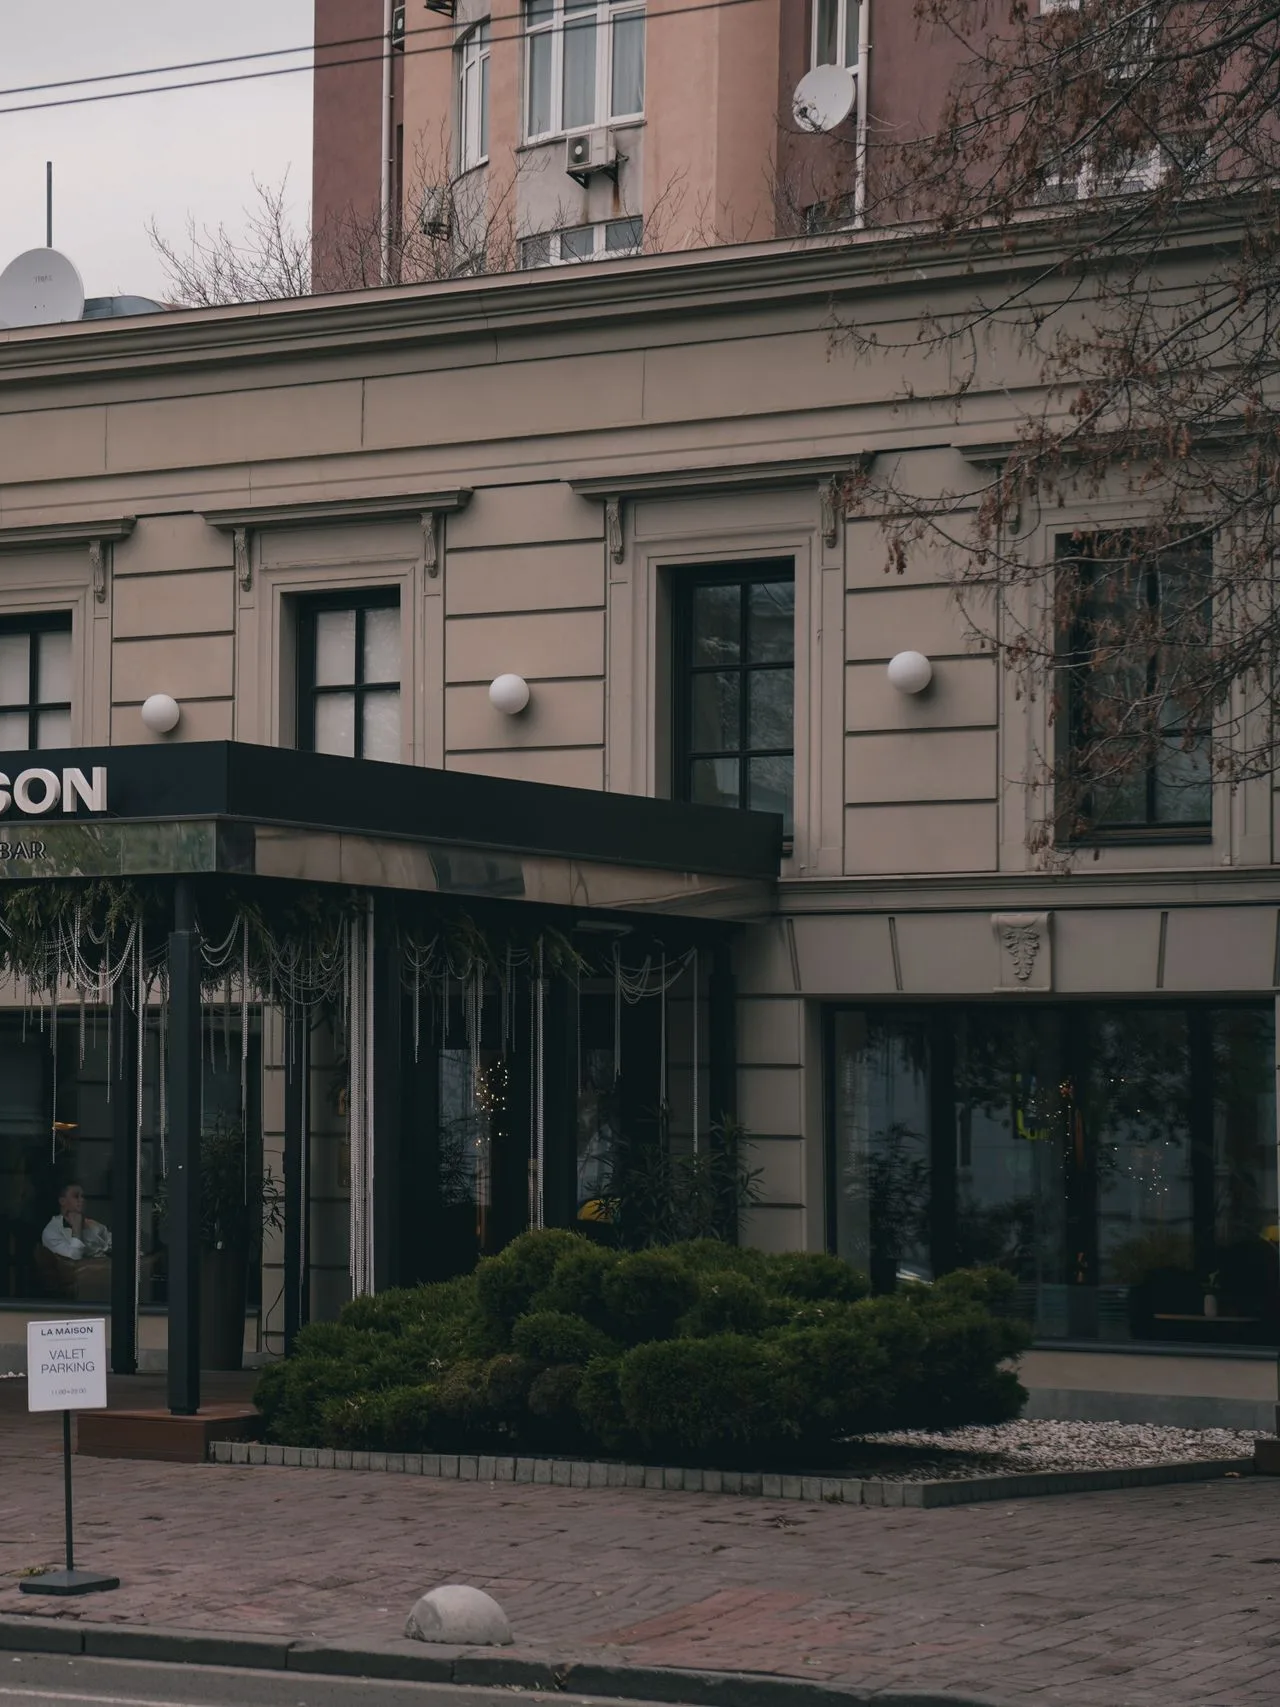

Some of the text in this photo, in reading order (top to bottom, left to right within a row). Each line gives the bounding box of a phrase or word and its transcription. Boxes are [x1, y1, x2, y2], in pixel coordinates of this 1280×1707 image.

[41, 1326, 94, 1336] LA MAISON
[49, 1348, 86, 1360] VALET
[41, 1361, 95, 1374] PARKING
